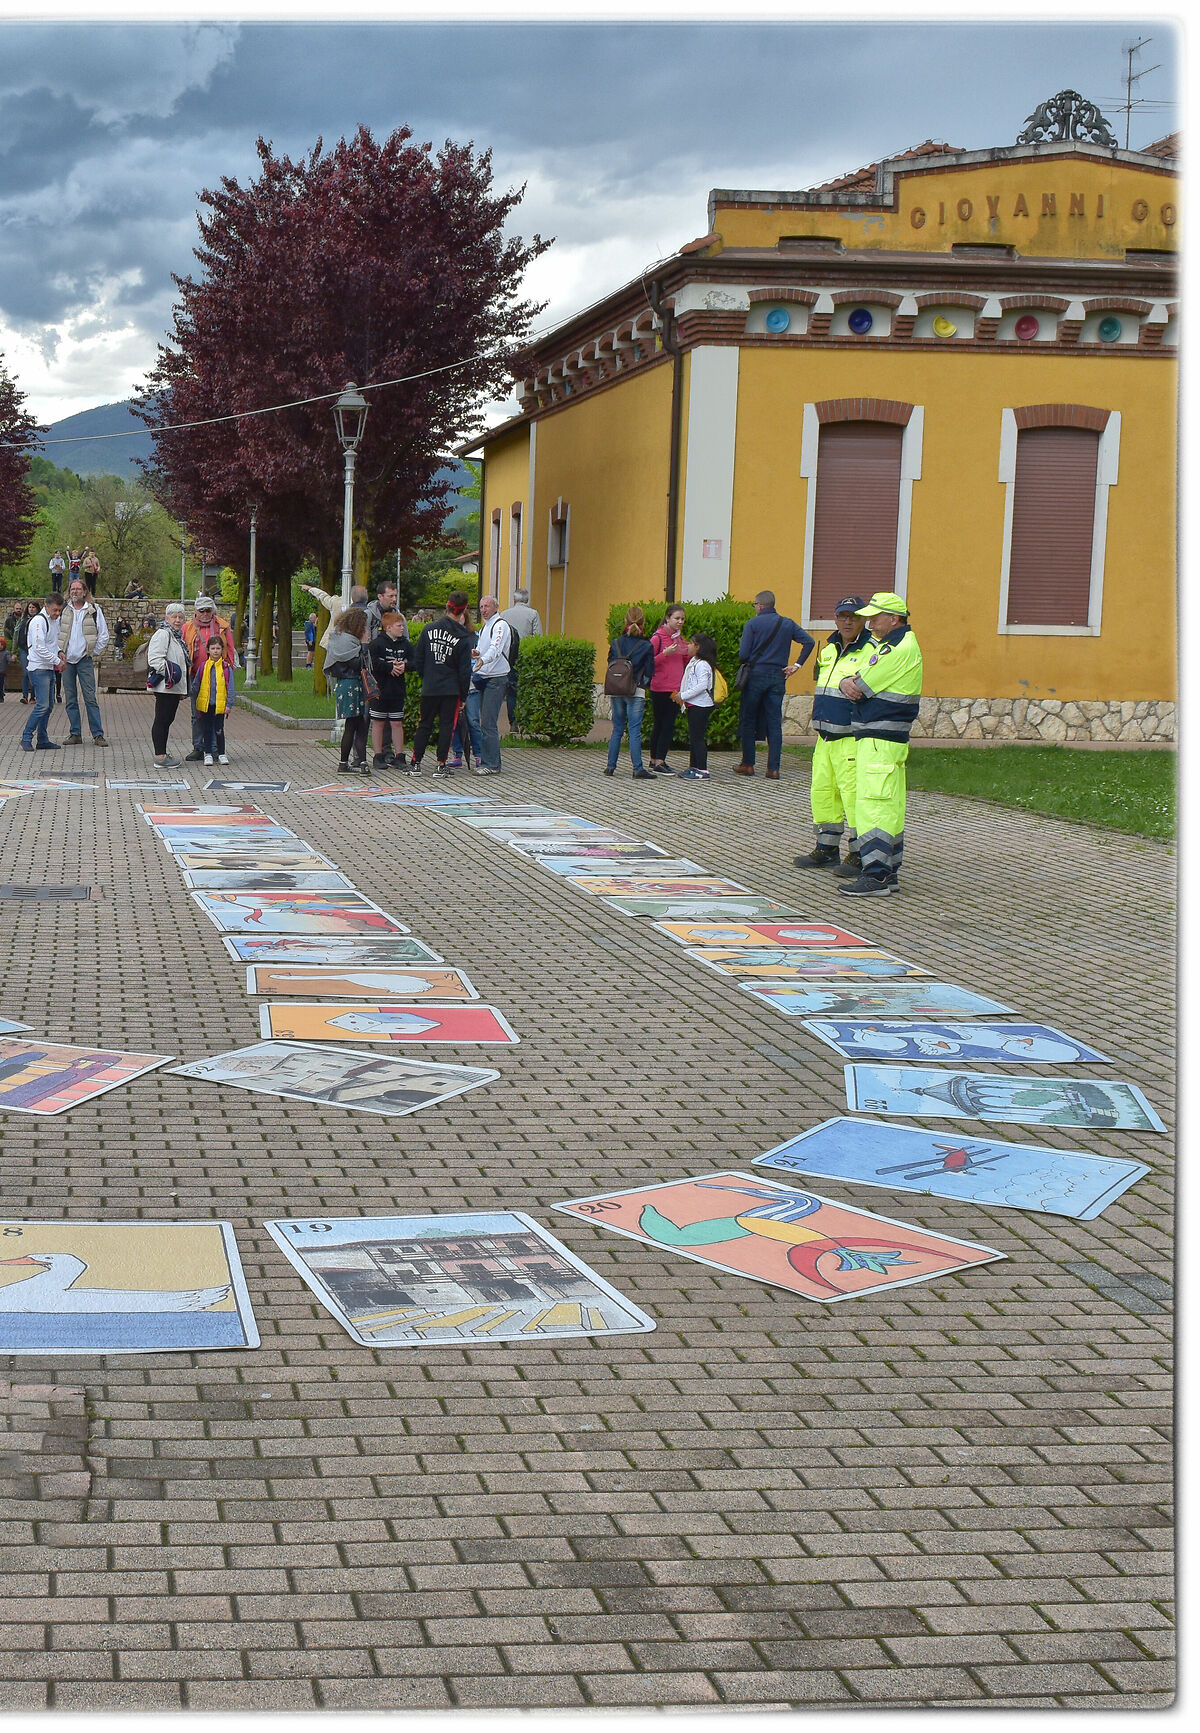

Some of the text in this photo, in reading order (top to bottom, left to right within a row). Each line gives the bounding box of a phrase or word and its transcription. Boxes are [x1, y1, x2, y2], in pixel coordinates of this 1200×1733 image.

[910, 192, 1104, 229] GIOVANNI
[184, 1065, 216, 1076] 52
[773, 1154, 809, 1168] 21
[578, 1201, 623, 1214] 20
[286, 1222, 333, 1234] 19
